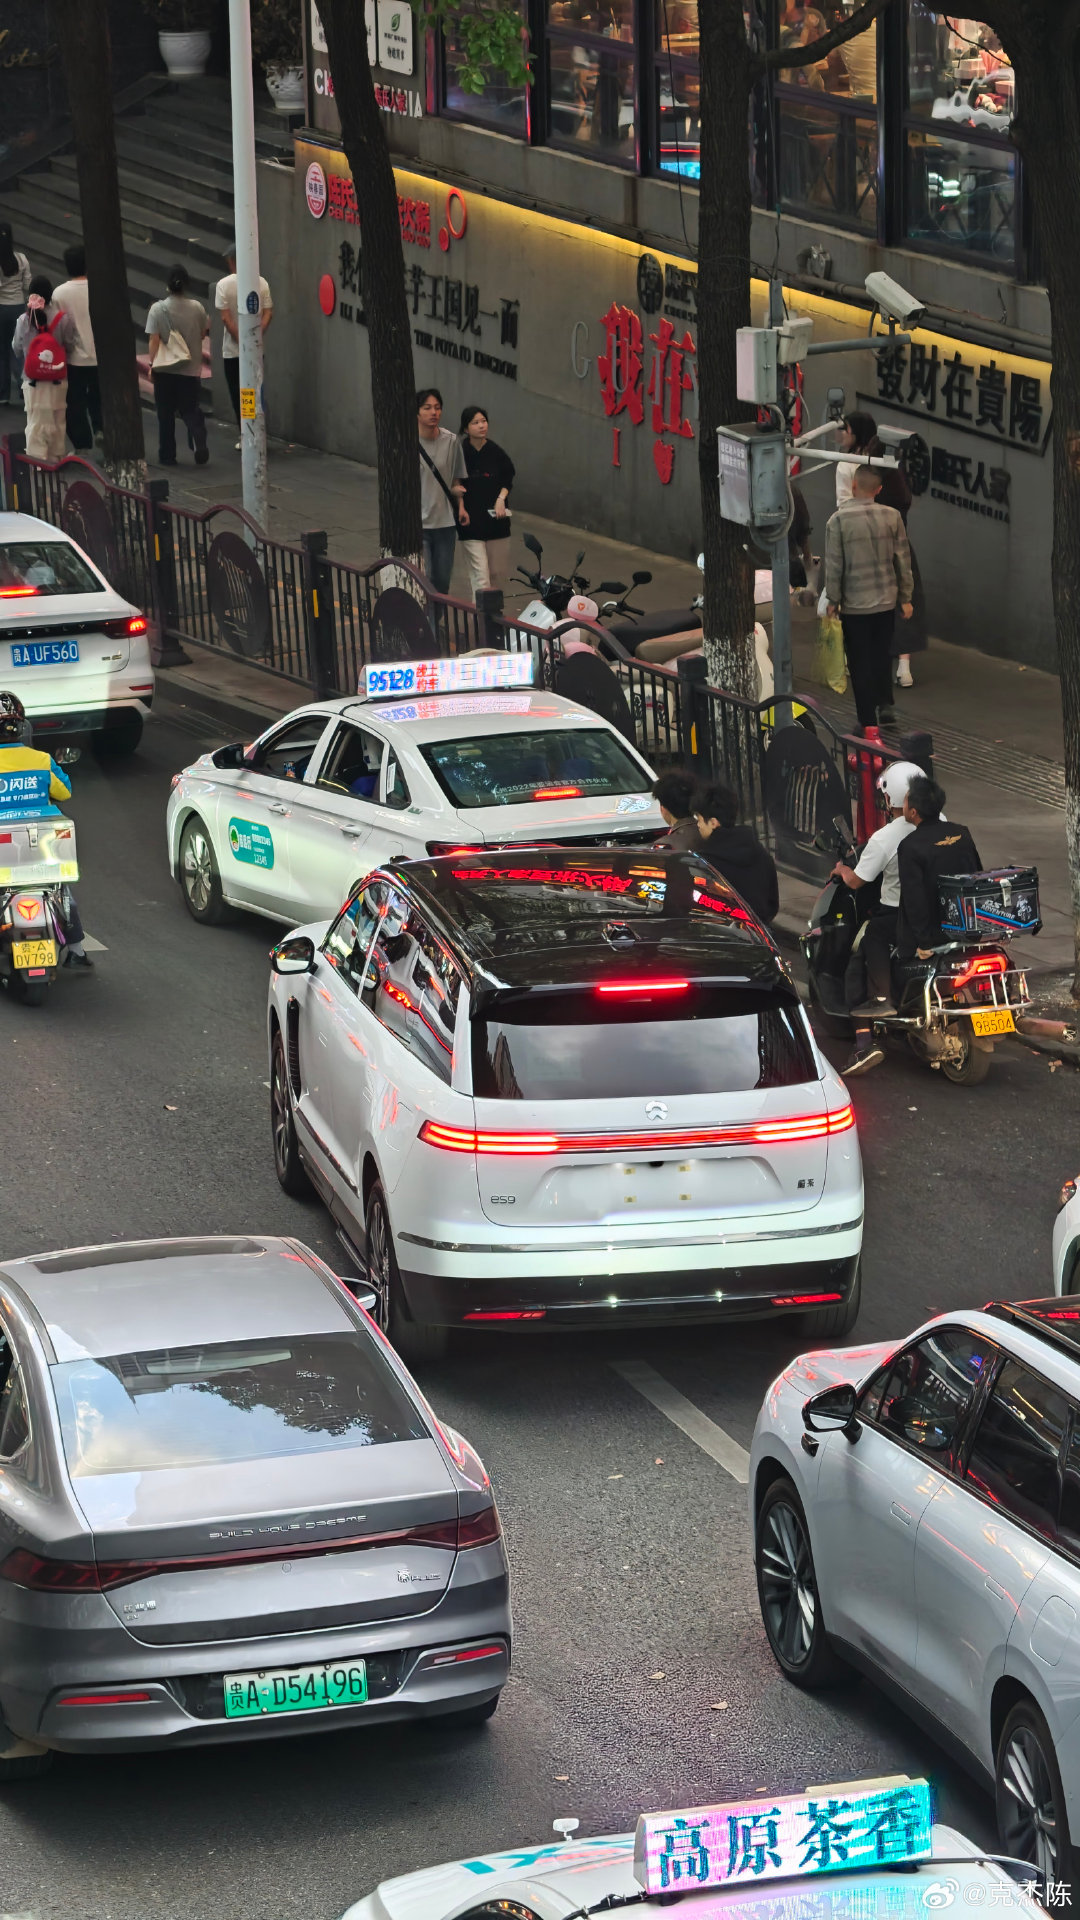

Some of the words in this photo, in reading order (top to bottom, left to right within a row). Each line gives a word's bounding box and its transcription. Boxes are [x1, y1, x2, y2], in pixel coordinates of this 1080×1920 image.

[9, 776, 38, 791] 闪送
[654, 1789, 921, 1889] 高原茶香
